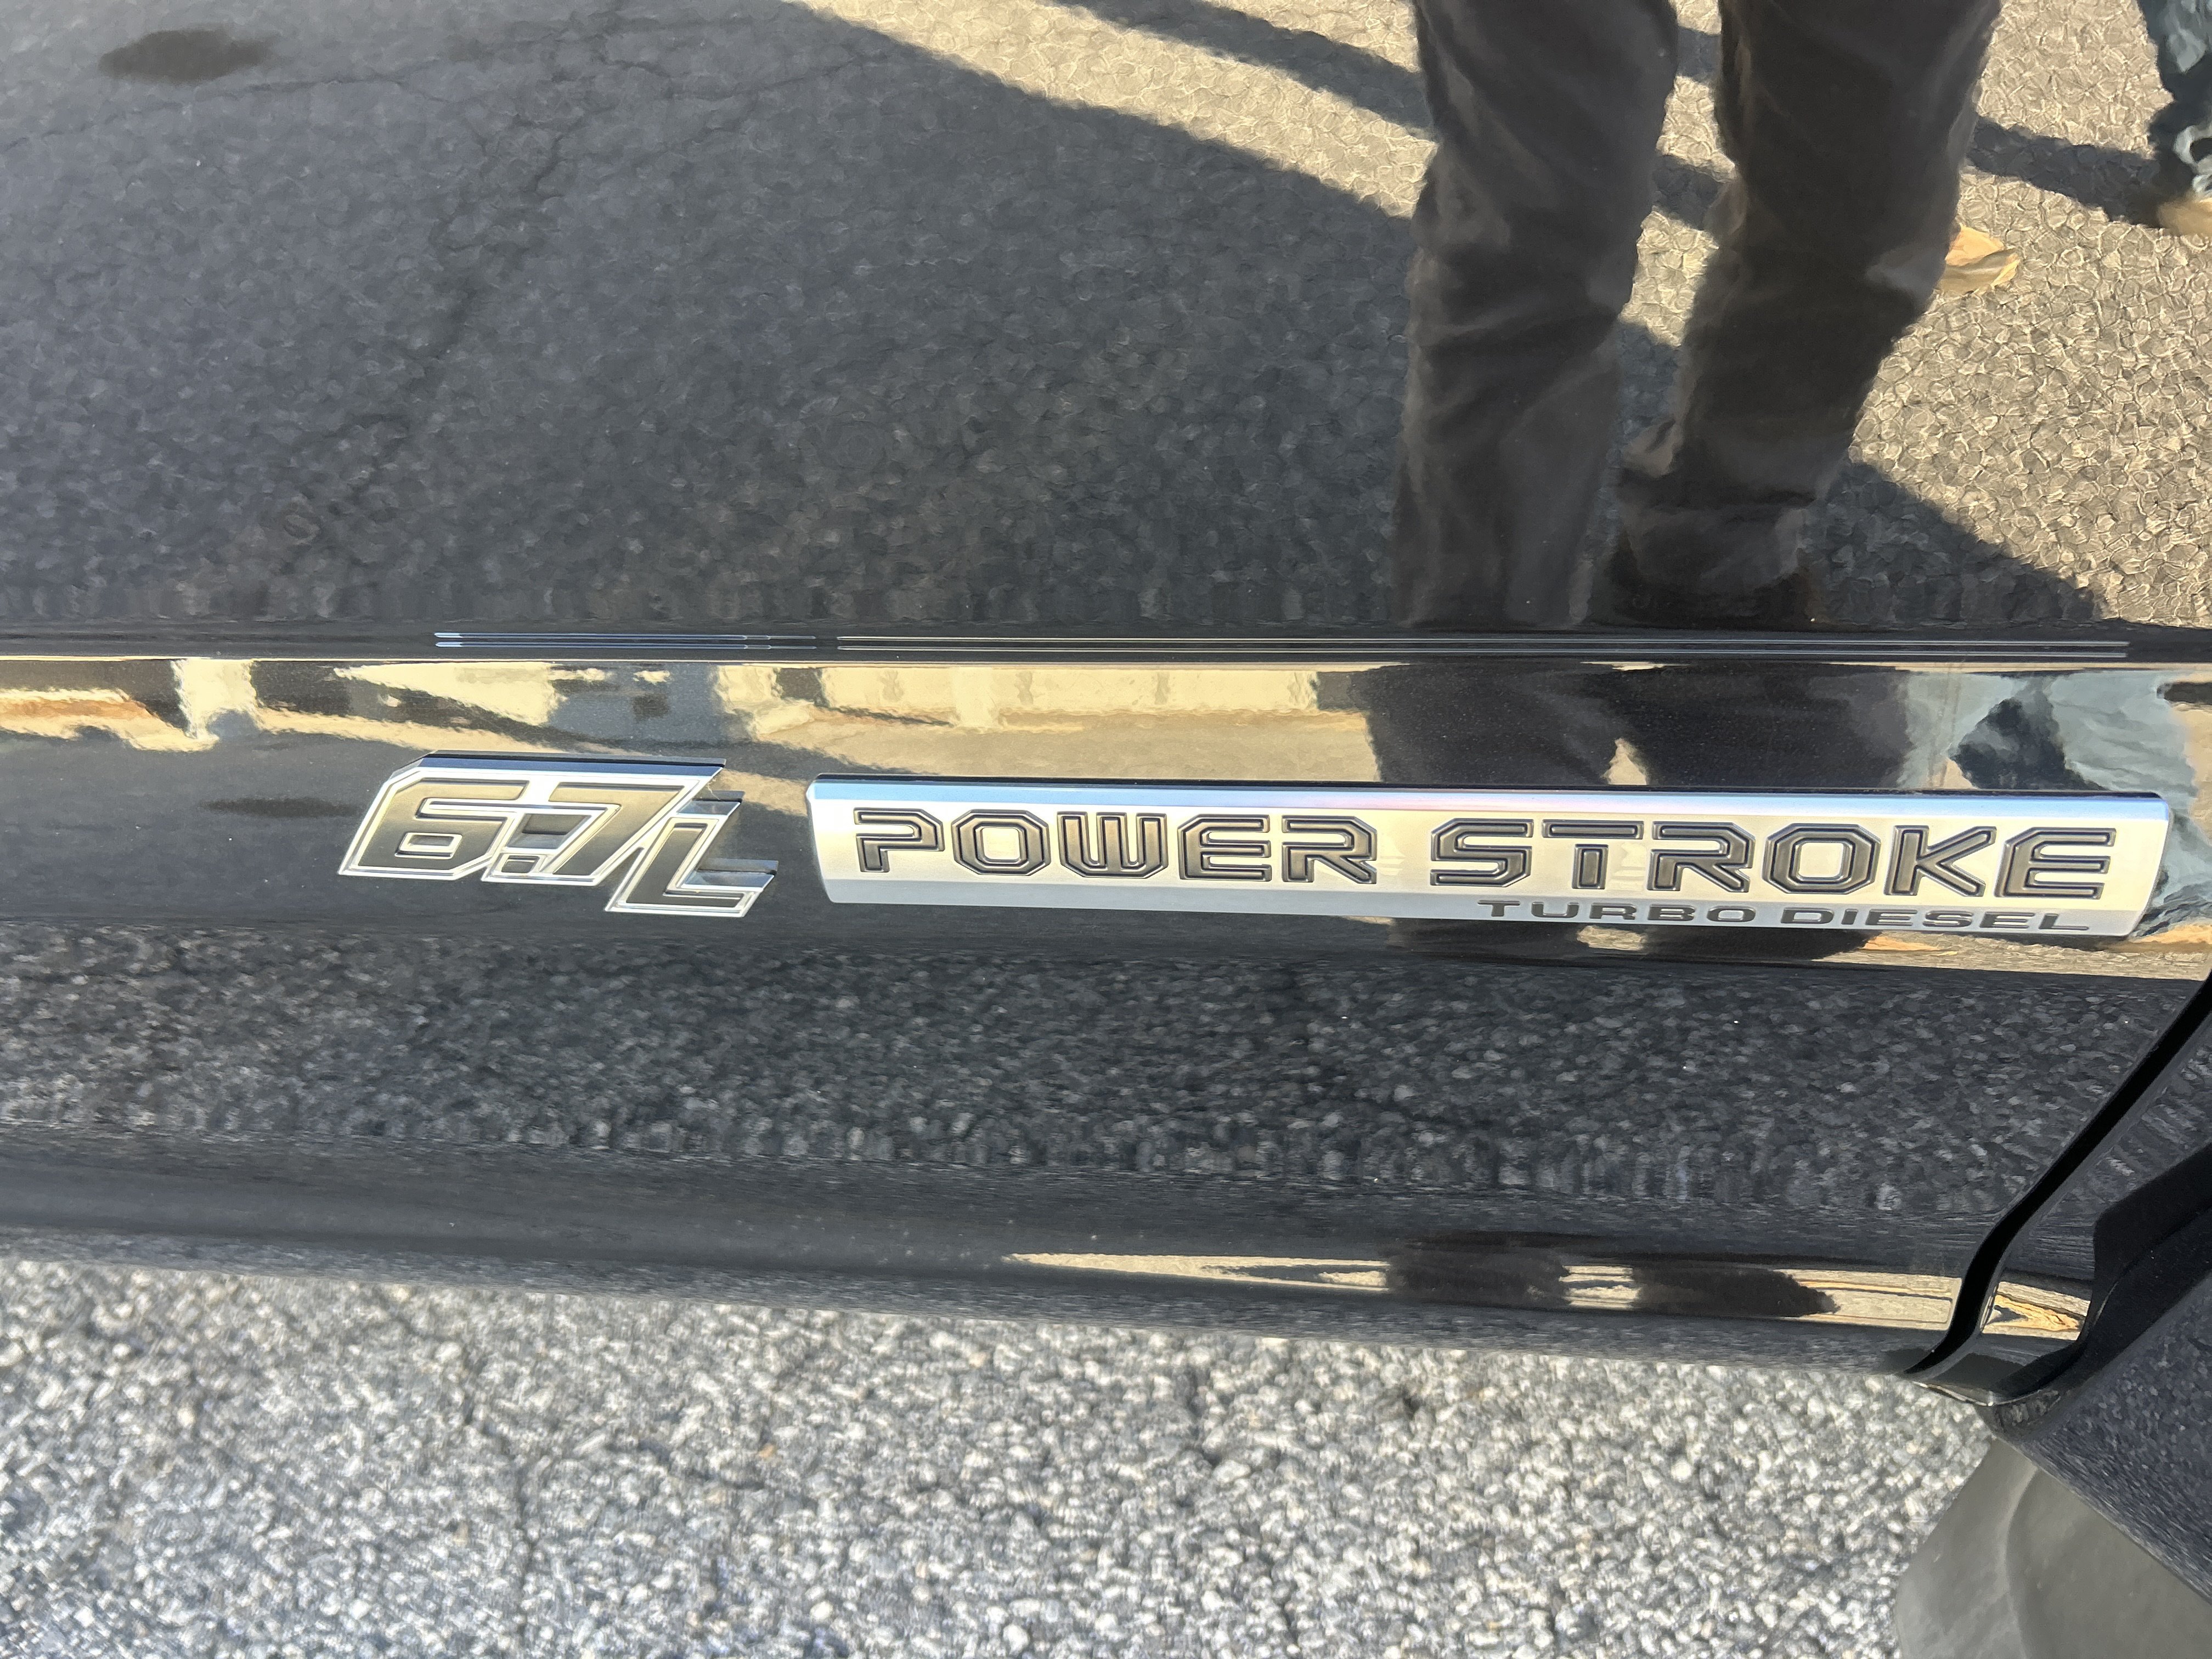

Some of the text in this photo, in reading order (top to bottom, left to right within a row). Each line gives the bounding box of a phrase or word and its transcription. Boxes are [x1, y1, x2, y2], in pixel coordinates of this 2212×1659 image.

[338, 758, 772, 917] 6.7L
[854, 807, 2117, 900] POWER STROKE
[1477, 901, 2090, 931] TURBO DIESEL
